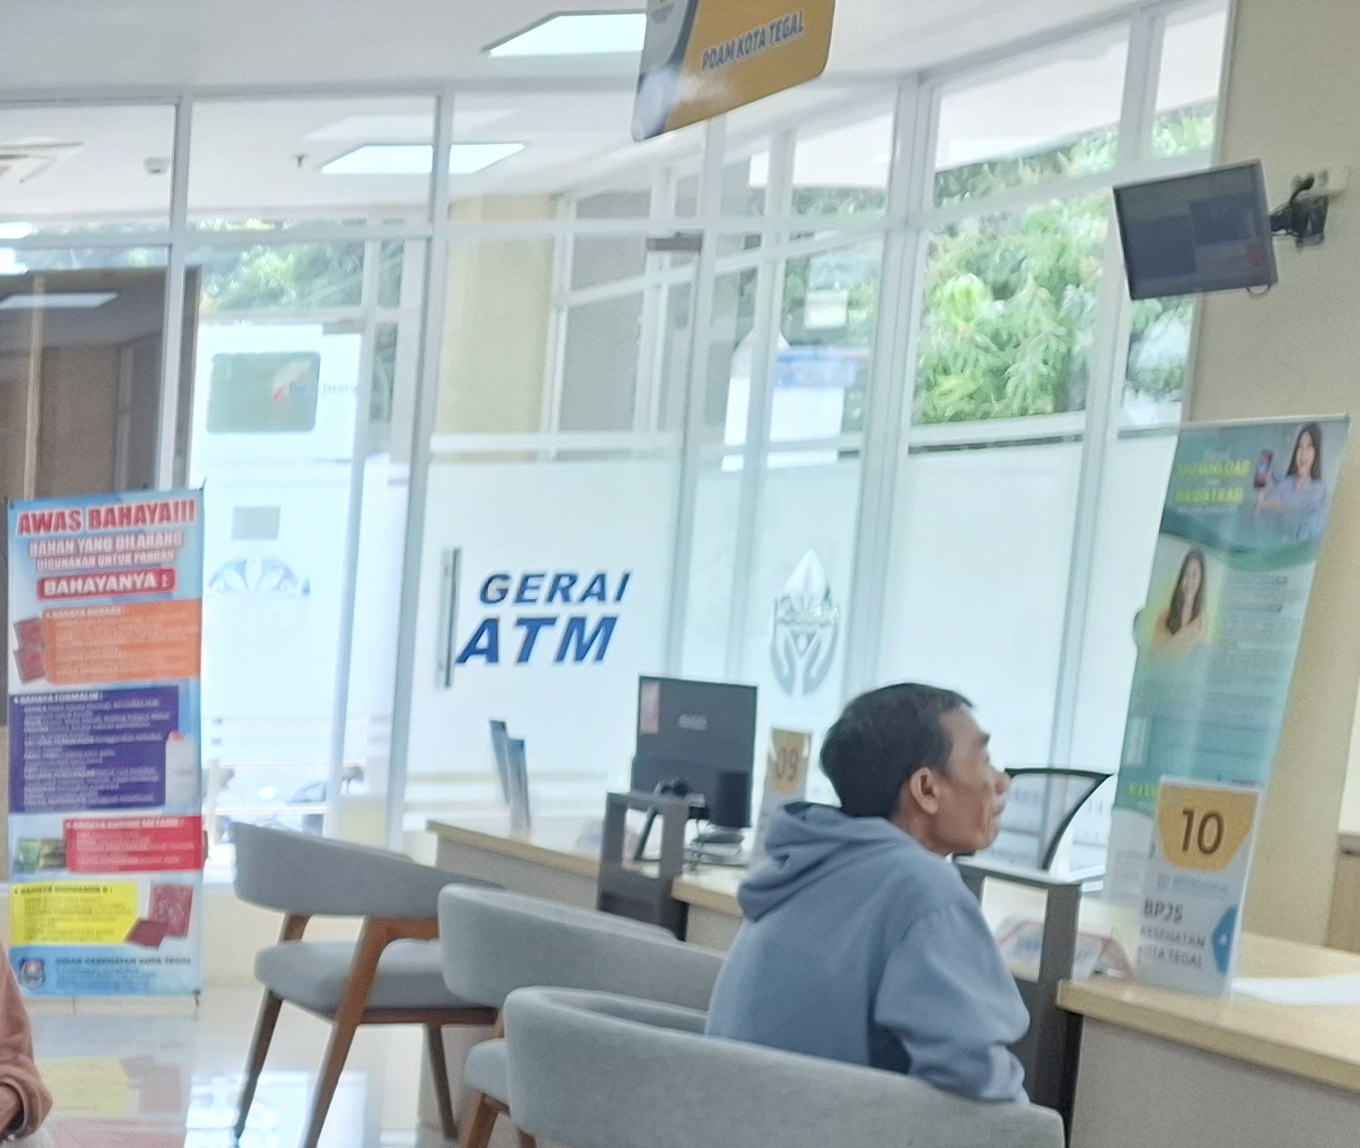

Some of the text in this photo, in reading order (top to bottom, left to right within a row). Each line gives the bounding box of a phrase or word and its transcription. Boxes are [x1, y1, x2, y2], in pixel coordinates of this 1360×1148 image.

[700, 10, 805, 71] PDAM KOTA TEGAL
[17, 508, 84, 536] AWAS
[29, 540, 75, 557] BAHAN
[76, 536, 114, 553] YANG
[36, 556, 96, 571] DIGUNAKAN
[97, 553, 133, 567] UNTUK
[43, 571, 158, 597] BAHAYANYA
[478, 571, 631, 605] GERAI
[454, 615, 619, 664] ATM
[1181, 806, 1226, 855] 10
[1142, 899, 1184, 923] BPJS
[1139, 925, 1207, 947] KESEHATAN
